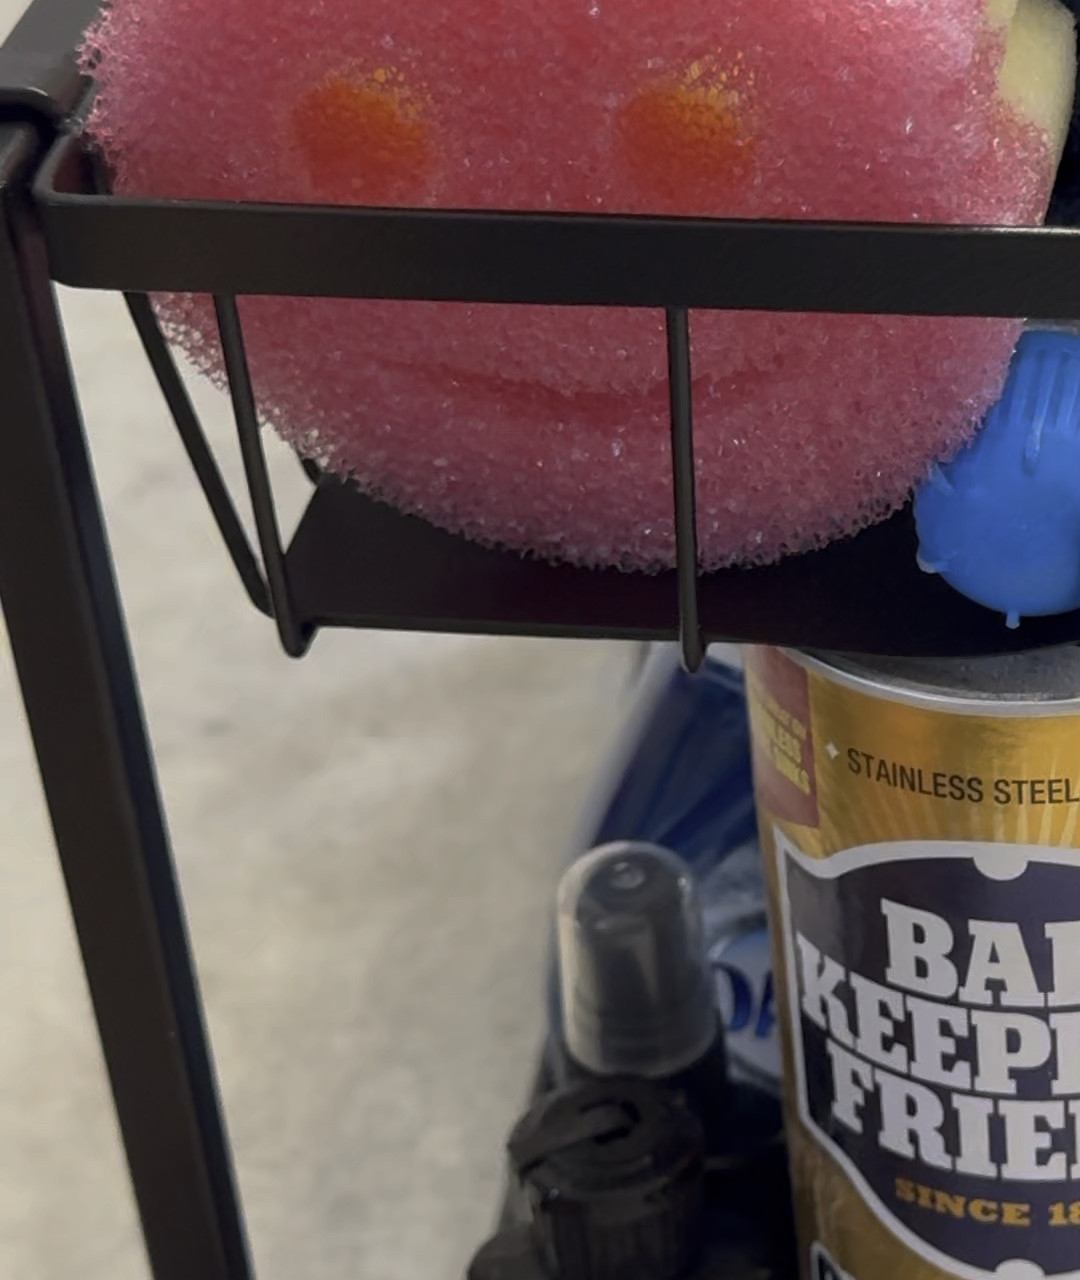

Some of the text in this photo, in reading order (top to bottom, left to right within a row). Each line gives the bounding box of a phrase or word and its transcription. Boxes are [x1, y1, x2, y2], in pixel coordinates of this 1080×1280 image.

[847, 746, 985, 804] STAINLESS
[992, 777, 1080, 805] STEEL
[894, 1177, 1032, 1227] SINCE
